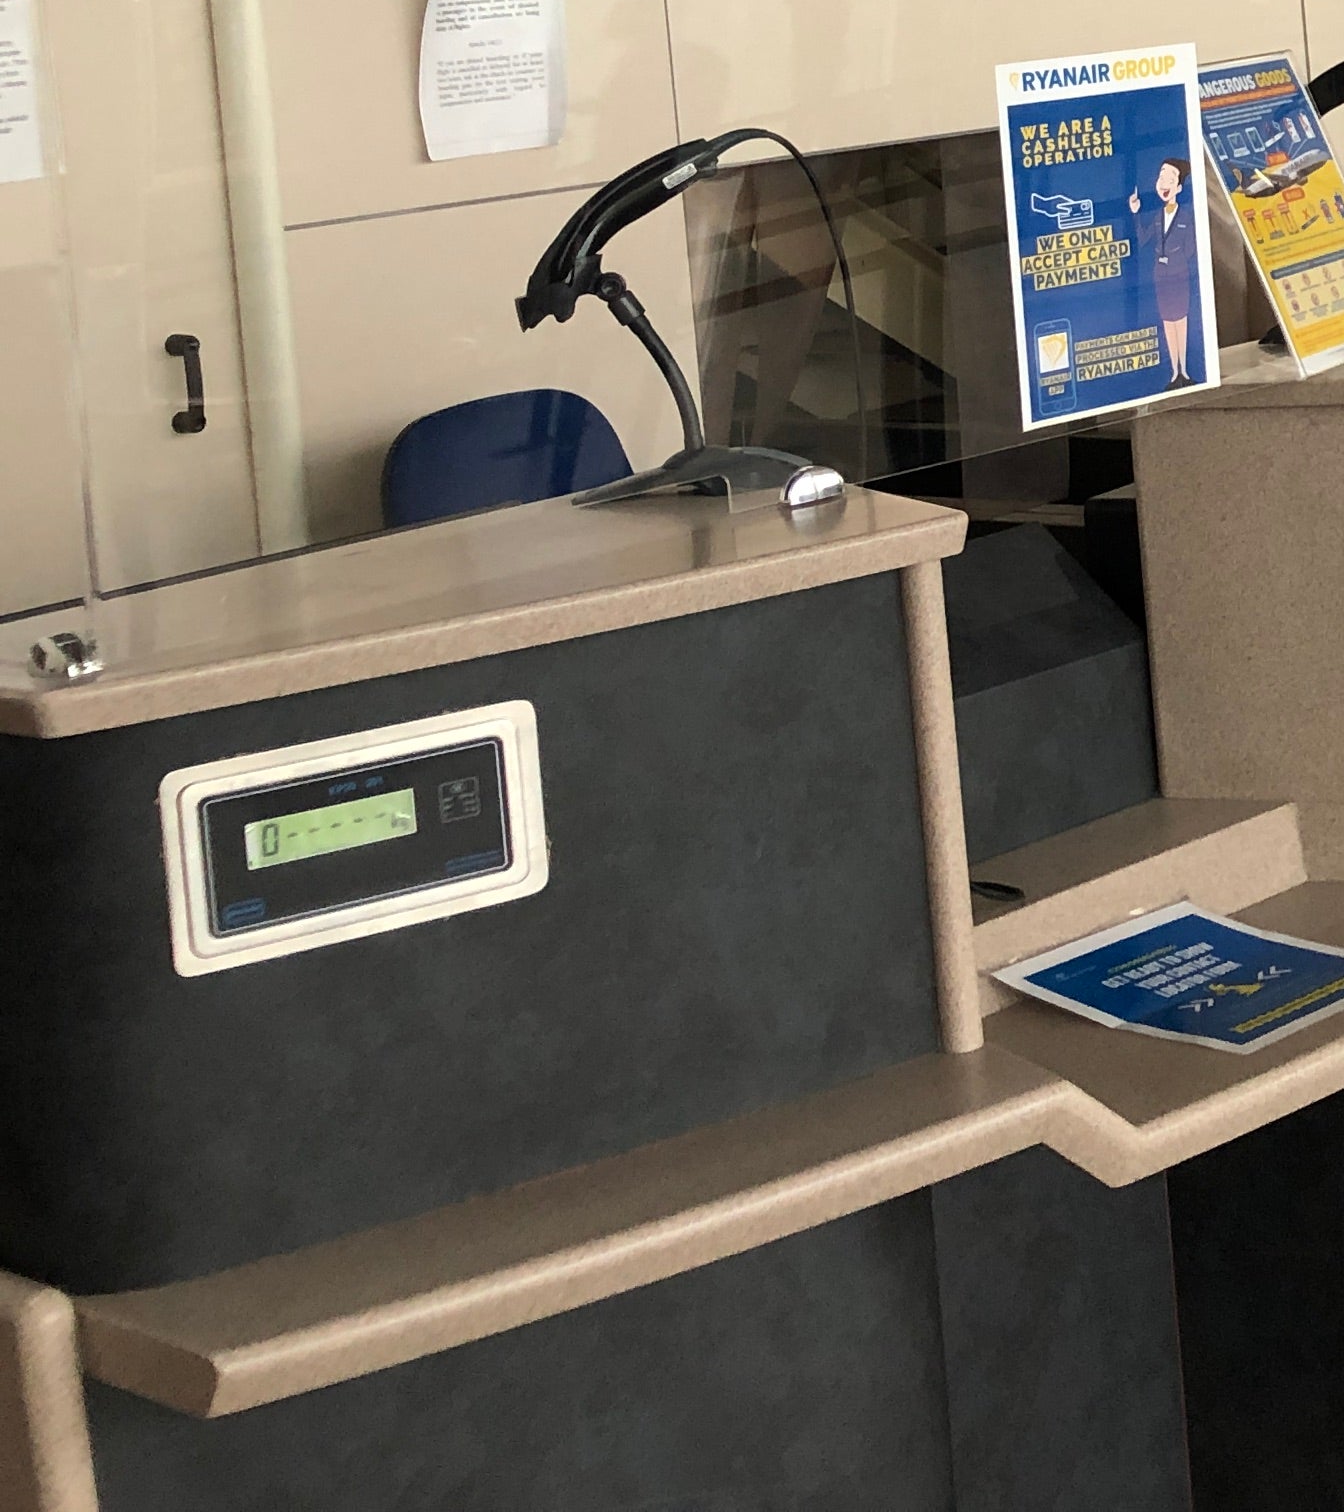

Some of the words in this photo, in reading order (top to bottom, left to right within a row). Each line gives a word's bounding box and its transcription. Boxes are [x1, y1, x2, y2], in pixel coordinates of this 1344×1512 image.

[1022, 63, 1110, 92] RYANAIR
[1113, 54, 1176, 81] GROUP
[1254, 68, 1292, 88] GOODS
[1020, 123, 1049, 140] WE
[1058, 117, 1094, 136] ARE
[1101, 115, 1112, 131] A
[1021, 130, 1112, 156] CASHLESS
[1023, 144, 1113, 169] OPERATION
[1039, 234, 1065, 252] WE
[1069, 227, 1110, 247] ONLY
[1024, 249, 1082, 273] ACCEPT
[1087, 242, 1129, 261] CARD
[1036, 261, 1119, 289] PAYMENTS
[1077, 347, 1127, 363] PROCESSED
[1078, 359, 1134, 381] RYANAIR
[1137, 353, 1159, 367] APP
